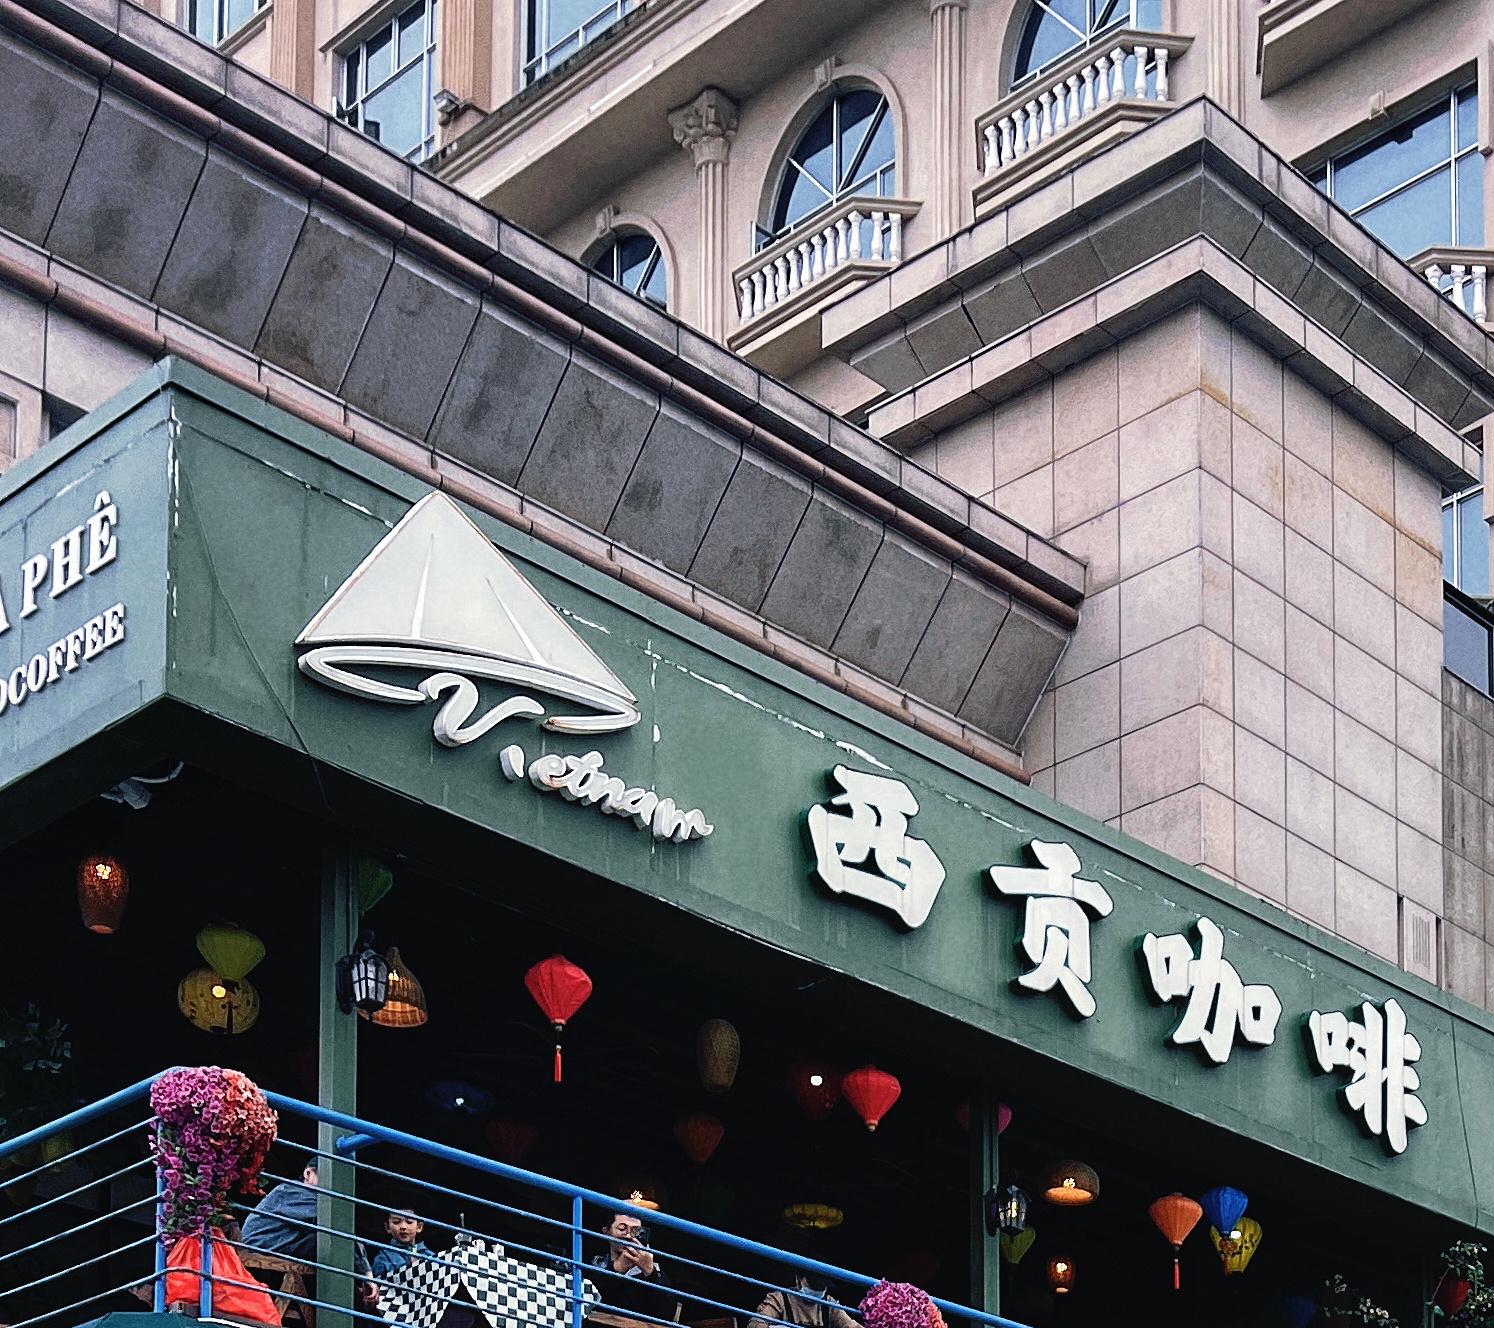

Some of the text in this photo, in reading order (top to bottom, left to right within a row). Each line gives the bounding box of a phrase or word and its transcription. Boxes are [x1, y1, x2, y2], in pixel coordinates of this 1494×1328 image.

[20, 490, 117, 618] PHÊ
[807, 764, 1429, 1156] 西贡咖啡
